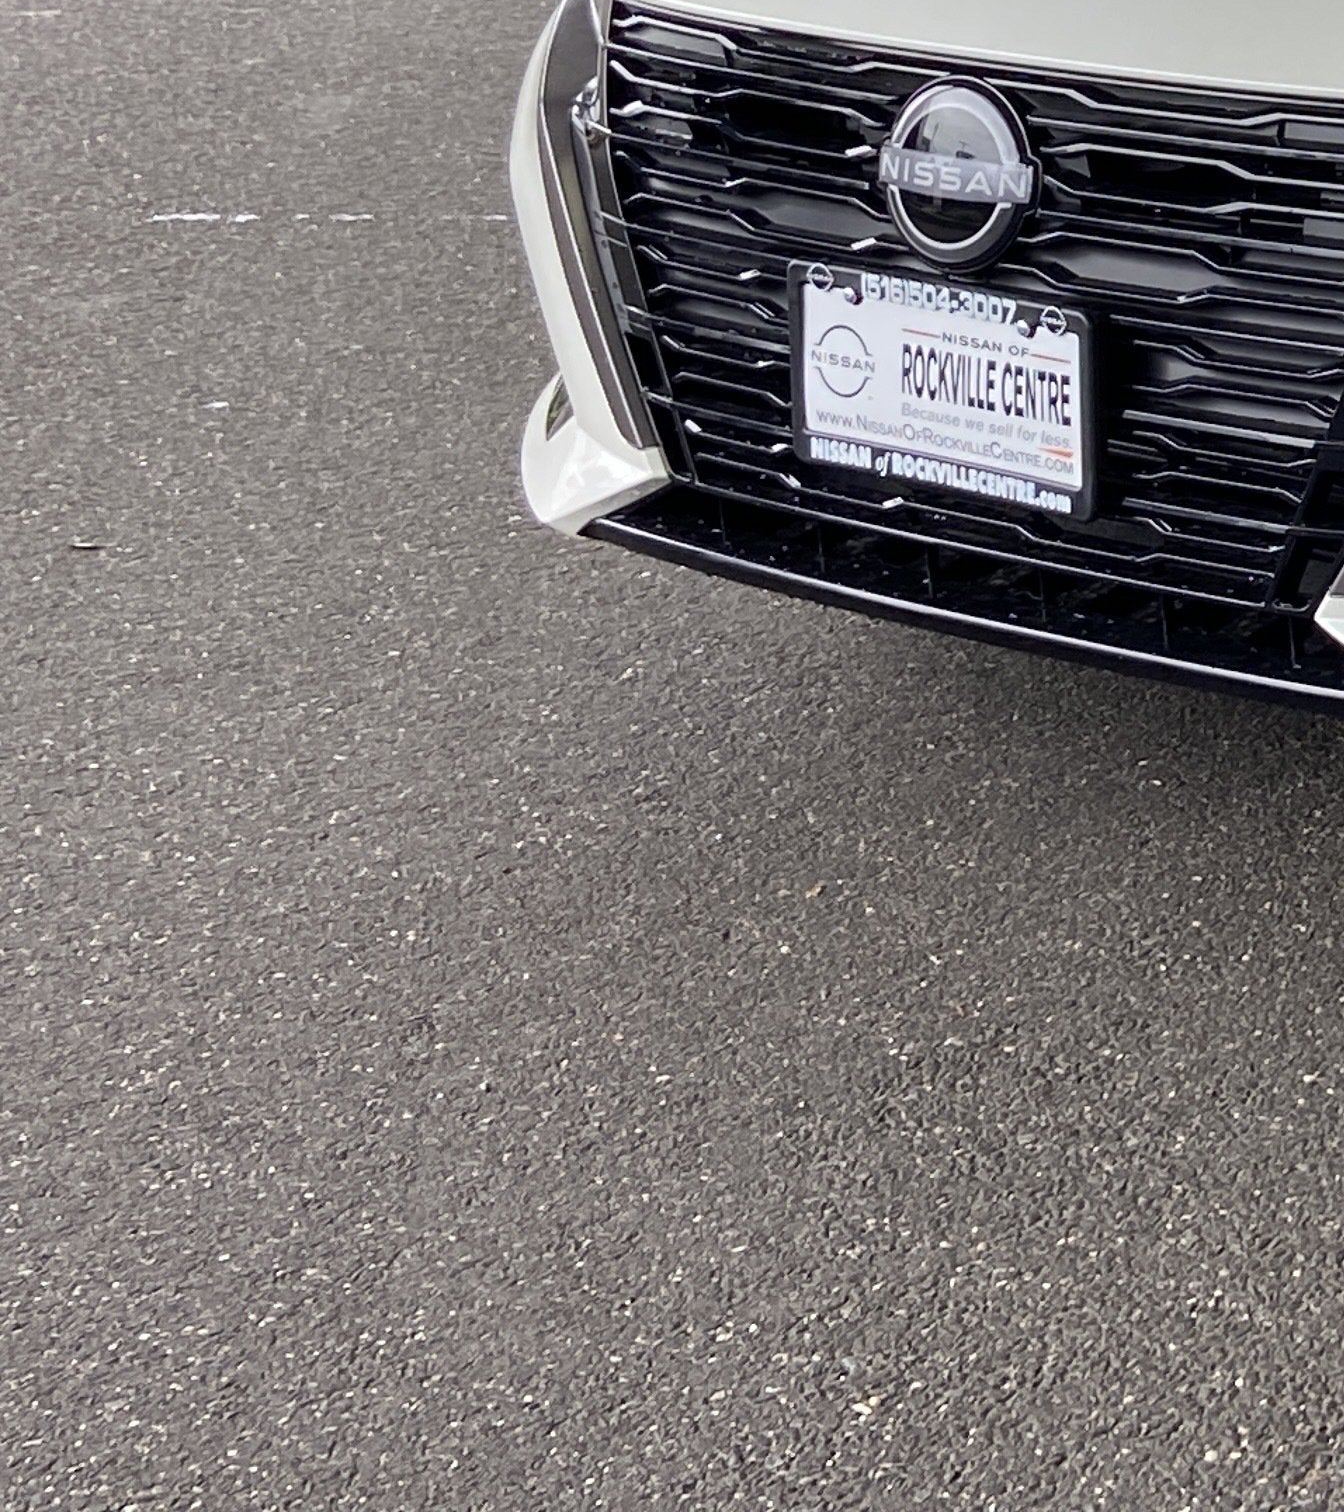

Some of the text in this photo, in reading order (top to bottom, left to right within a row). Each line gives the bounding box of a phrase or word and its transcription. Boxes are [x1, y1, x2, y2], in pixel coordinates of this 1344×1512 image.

[880, 152, 1028, 199] NISSAN
[811, 348, 876, 374] NISSAN
[942, 332, 1030, 358] NISSAN OF
[901, 343, 1072, 427] ROCKVILLE CENTRE
[901, 402, 961, 427] Because
[965, 417, 984, 432] we
[988, 422, 1014, 439] sell
[1017, 425, 1037, 442] for
[810, 437, 872, 469] NISSAN
[875, 450, 892, 477] of
